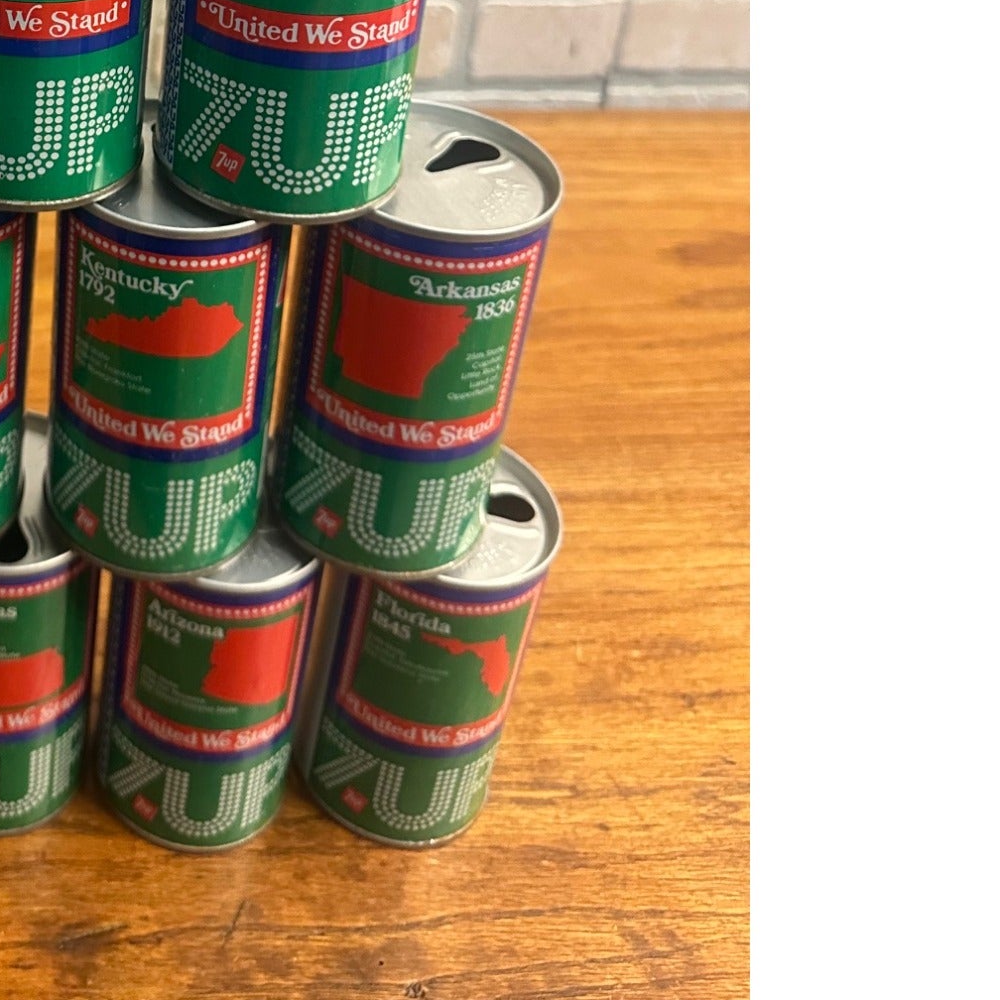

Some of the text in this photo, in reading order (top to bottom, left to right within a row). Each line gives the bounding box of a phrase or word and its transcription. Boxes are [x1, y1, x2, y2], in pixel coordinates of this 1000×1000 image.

[5, 5, 43, 33] We
[49, 1, 119, 38] Stand
[208, 1, 411, 50] United We Stand
[178, 57, 413, 196] 7UP
[216, 151, 239, 171] 7up
[78, 269, 116, 305] 1792
[79, 245, 195, 301] Kentucky
[408, 274, 522, 301] Arkansas
[474, 295, 517, 321] 1836
[68, 385, 244, 450] United We Stand
[315, 389, 494, 449] United We Stand
[52, 421, 257, 560] 7UP
[284, 425, 496, 559] 7UP
[147, 597, 226, 641] Arizona
[371, 609, 412, 642] 1845
[375, 588, 452, 635] Florida
[146, 617, 182, 647] 1912
[6, 705, 37, 726] We
[420, 725, 451, 745] We
[201, 729, 233, 751] We
[109, 725, 292, 838] 7UP
